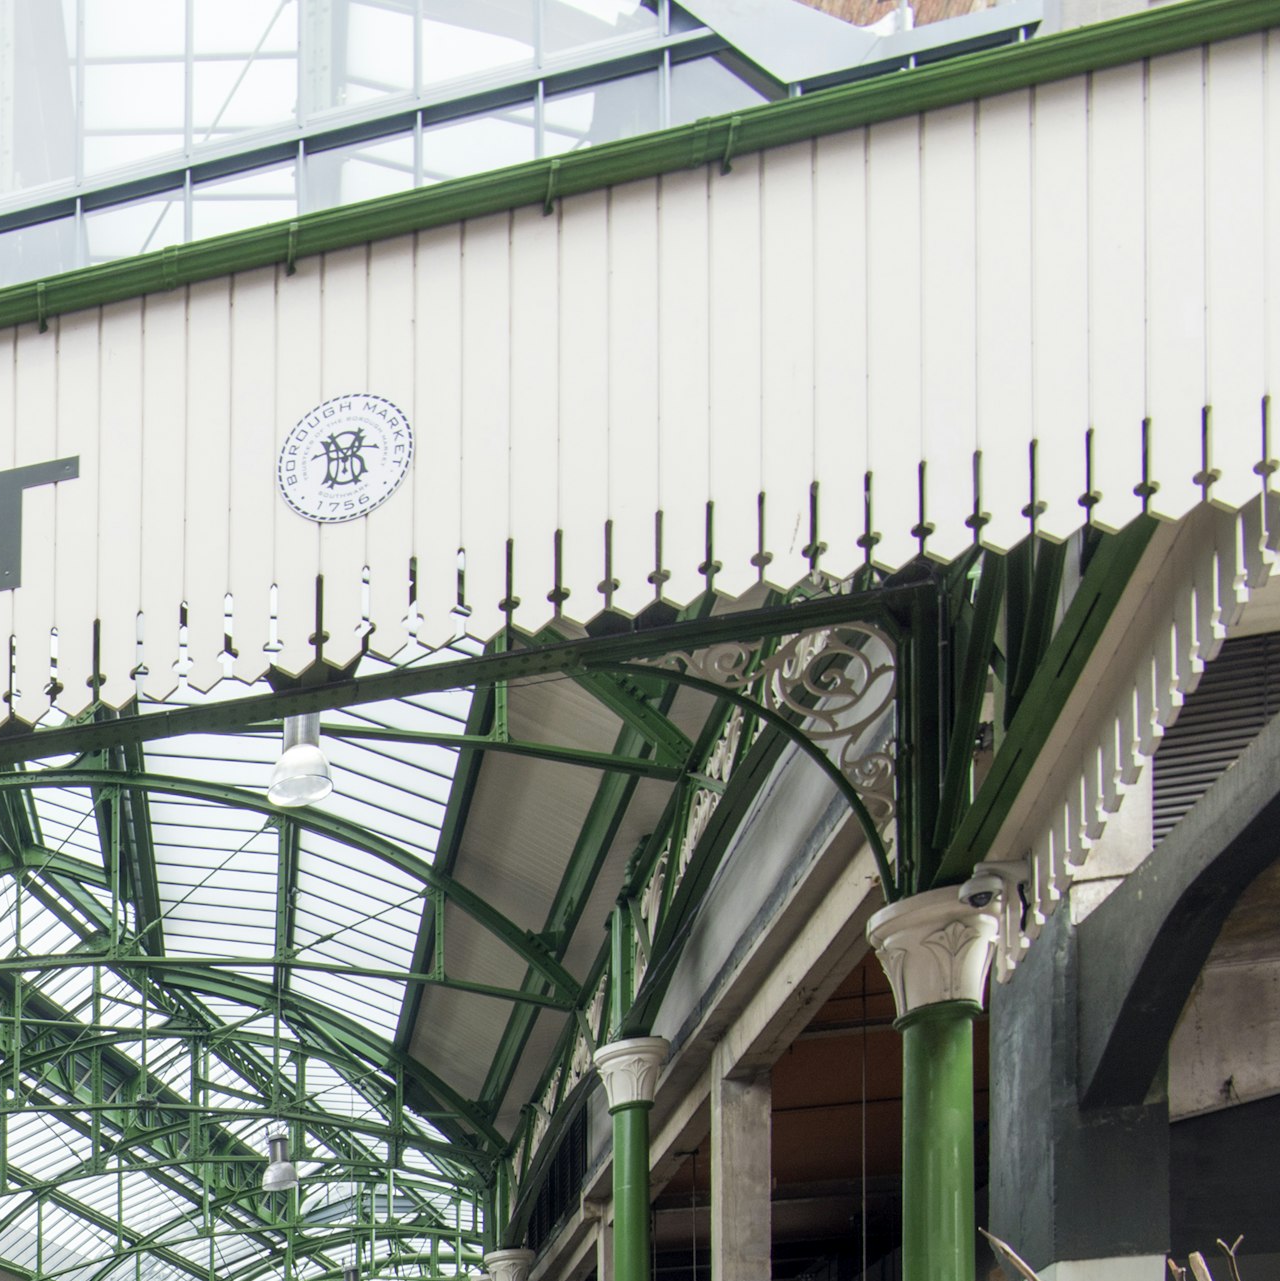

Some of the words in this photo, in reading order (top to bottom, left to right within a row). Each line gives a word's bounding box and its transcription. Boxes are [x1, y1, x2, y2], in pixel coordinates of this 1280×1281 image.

[286, 401, 352, 487] BOROUGH
[362, 401, 406, 468] MARKET
[316, 493, 371, 513] 1756
